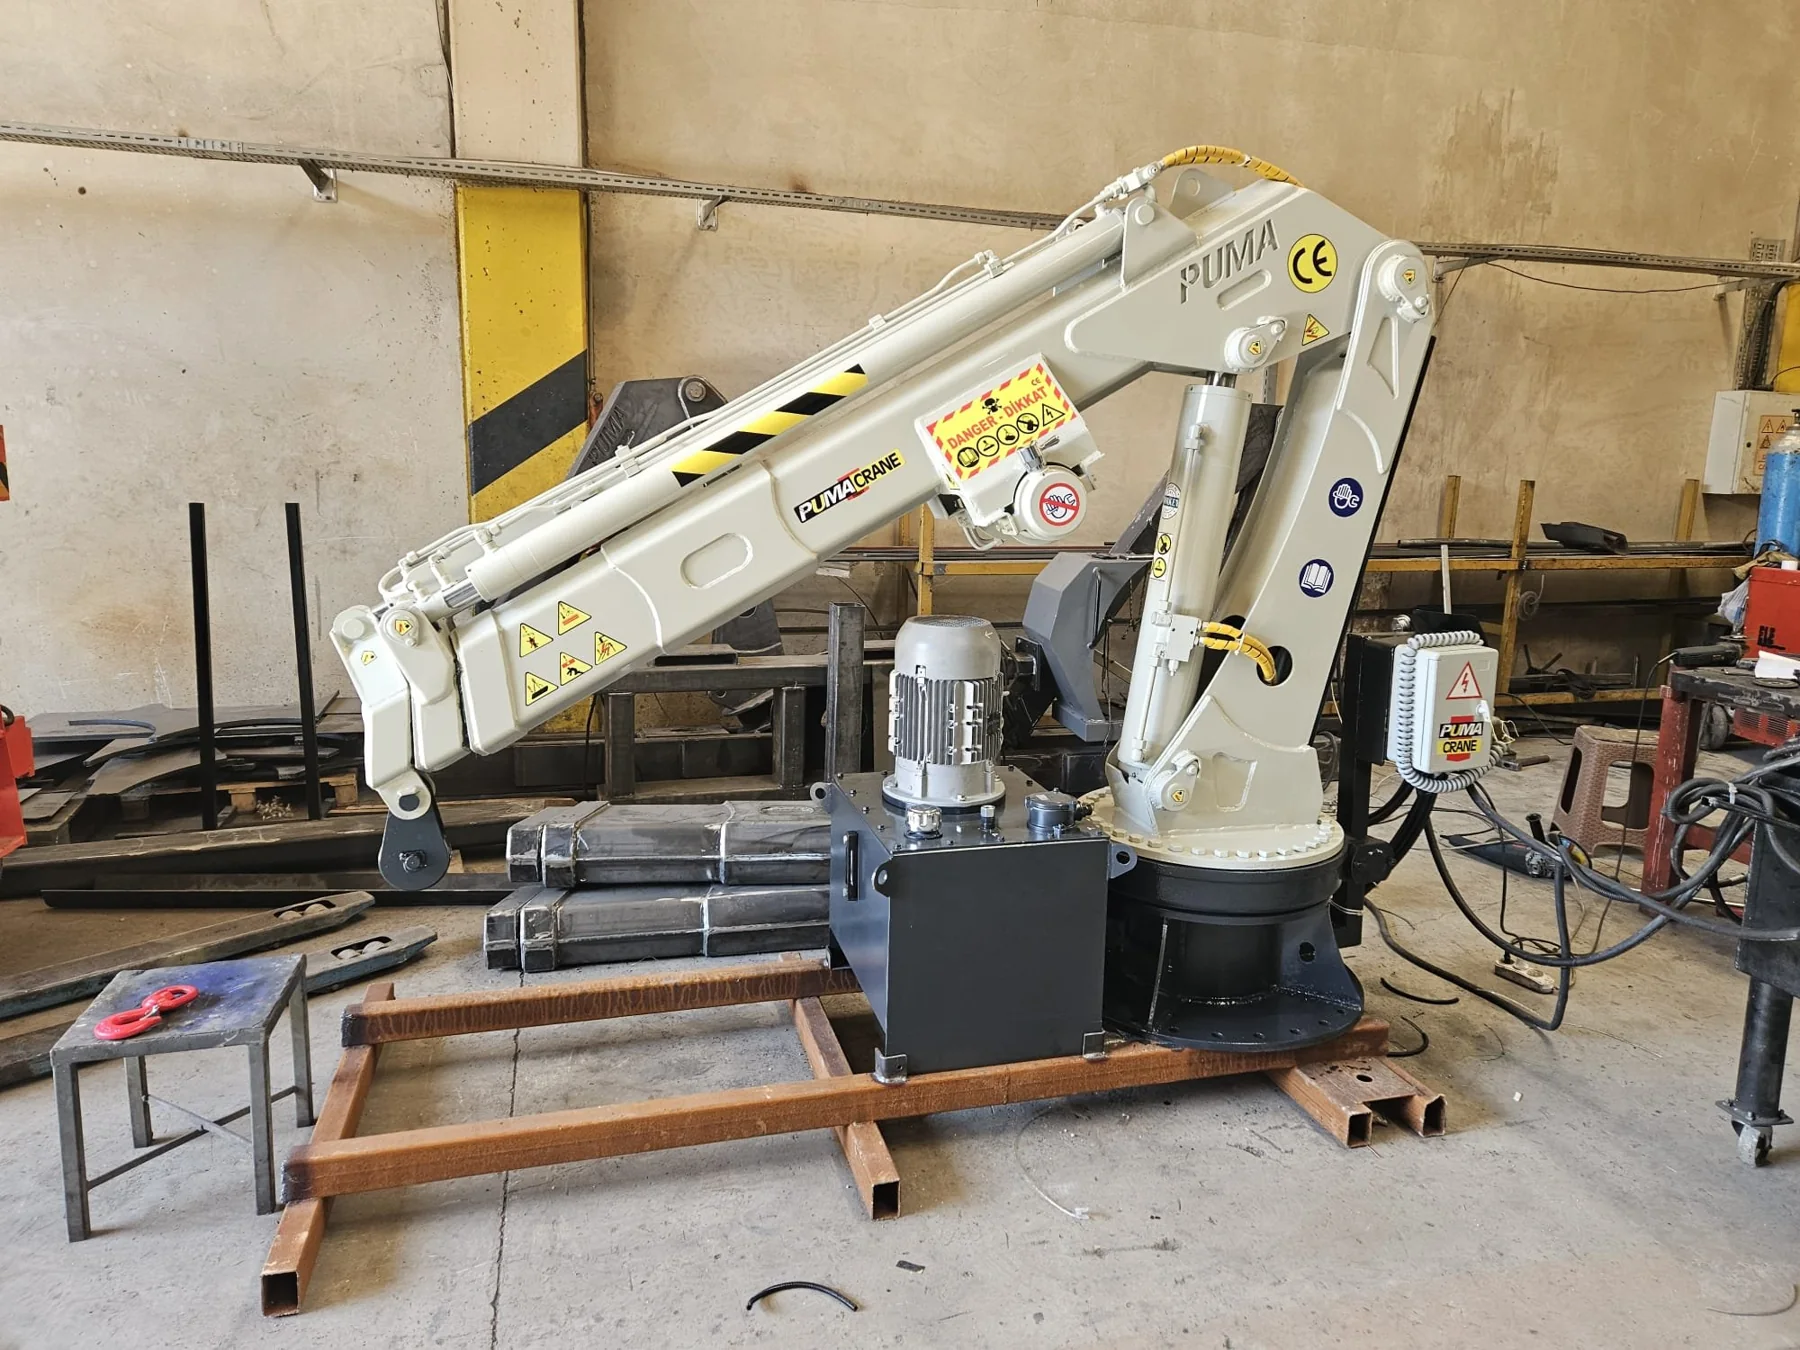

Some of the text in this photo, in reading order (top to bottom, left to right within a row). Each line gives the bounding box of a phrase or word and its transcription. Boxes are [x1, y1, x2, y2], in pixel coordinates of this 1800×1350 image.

[1180, 218, 1280, 304] PUMA
[1292, 240, 1332, 284] CE
[587, 405, 625, 465] PUMA
[947, 417, 998, 449] DANGER
[1003, 386, 1048, 419] DİKKAT
[1440, 722, 1483, 738] PUMA
[1442, 739, 1477, 753] CRANE
